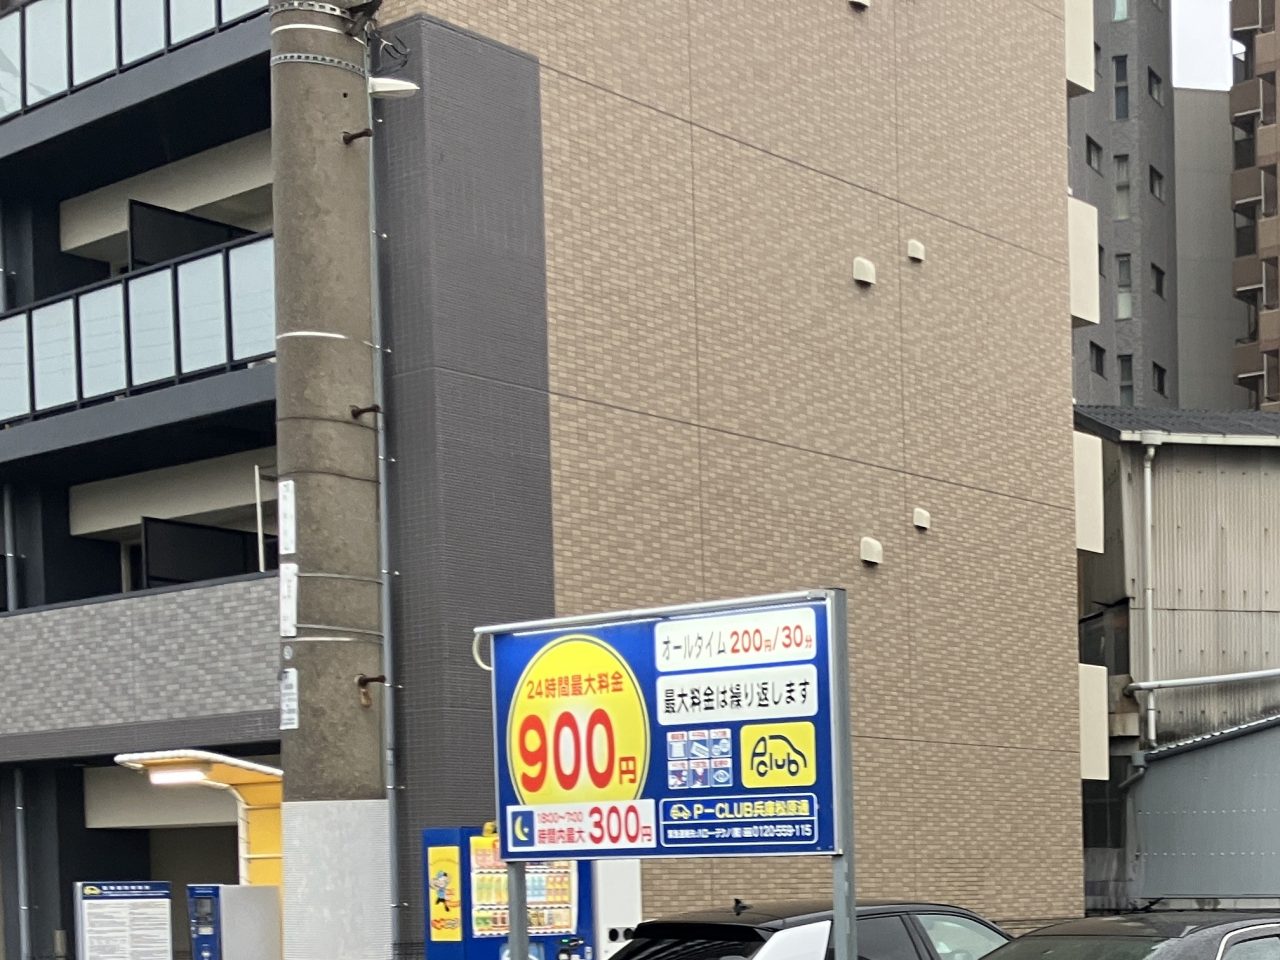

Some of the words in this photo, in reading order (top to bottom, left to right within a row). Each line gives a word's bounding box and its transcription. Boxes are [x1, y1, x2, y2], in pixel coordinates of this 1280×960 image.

[662, 631, 726, 660] オールタイム
[526, 671, 623, 699] 24時間最大料金
[664, 679, 810, 714] 最大料金は繰り返します
[518, 708, 637, 793] 900円
[589, 805, 652, 844] 300円
